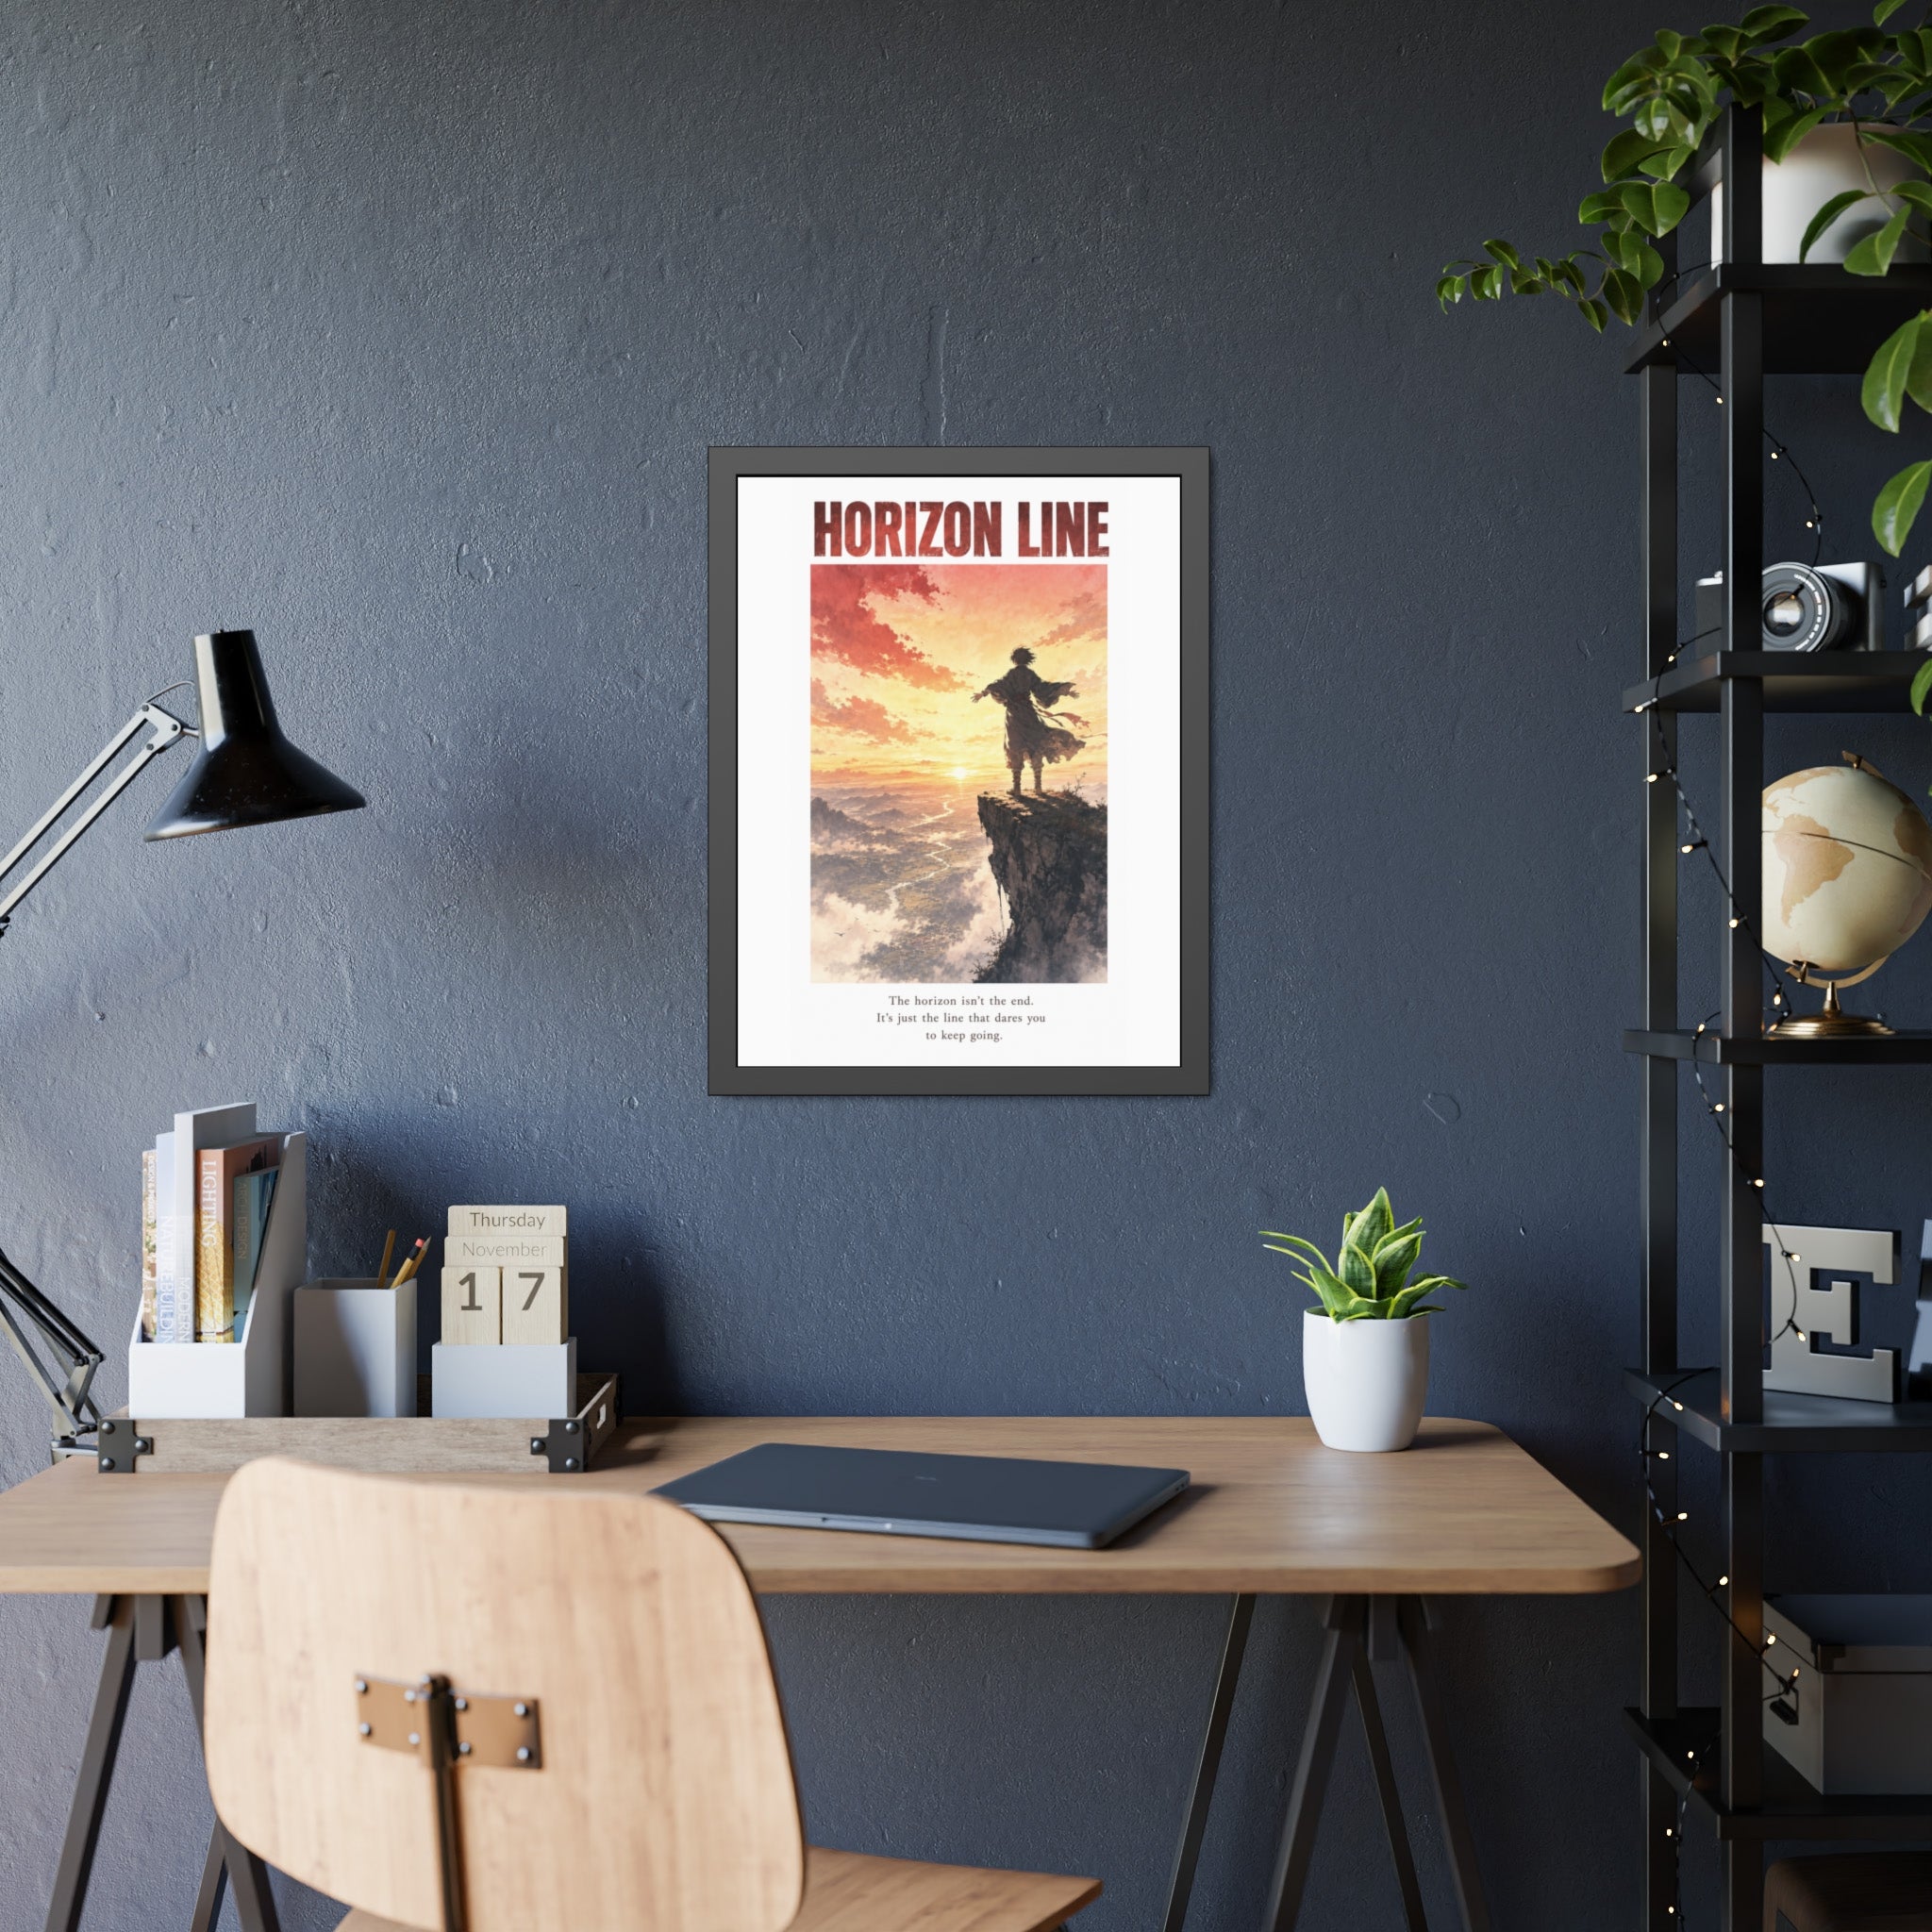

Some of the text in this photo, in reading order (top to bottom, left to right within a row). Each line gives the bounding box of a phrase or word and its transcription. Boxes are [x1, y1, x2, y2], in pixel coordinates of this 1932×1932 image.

[814, 501, 1109, 558] HORIZON LINE
[888, 995, 1033, 1007] The horizon isn't the end.
[876, 1011, 1045, 1026] It's just the line that dares you
[925, 1029, 1003, 1043] to keep going.
[201, 1160, 217, 1247] LIGHTING
[469, 1212, 546, 1229] Thursday
[237, 1216, 248, 1259] DESIGN
[462, 1242, 547, 1257] November
[177, 1276, 191, 1342] MODERN
[1762, 1223, 1894, 1405] E
